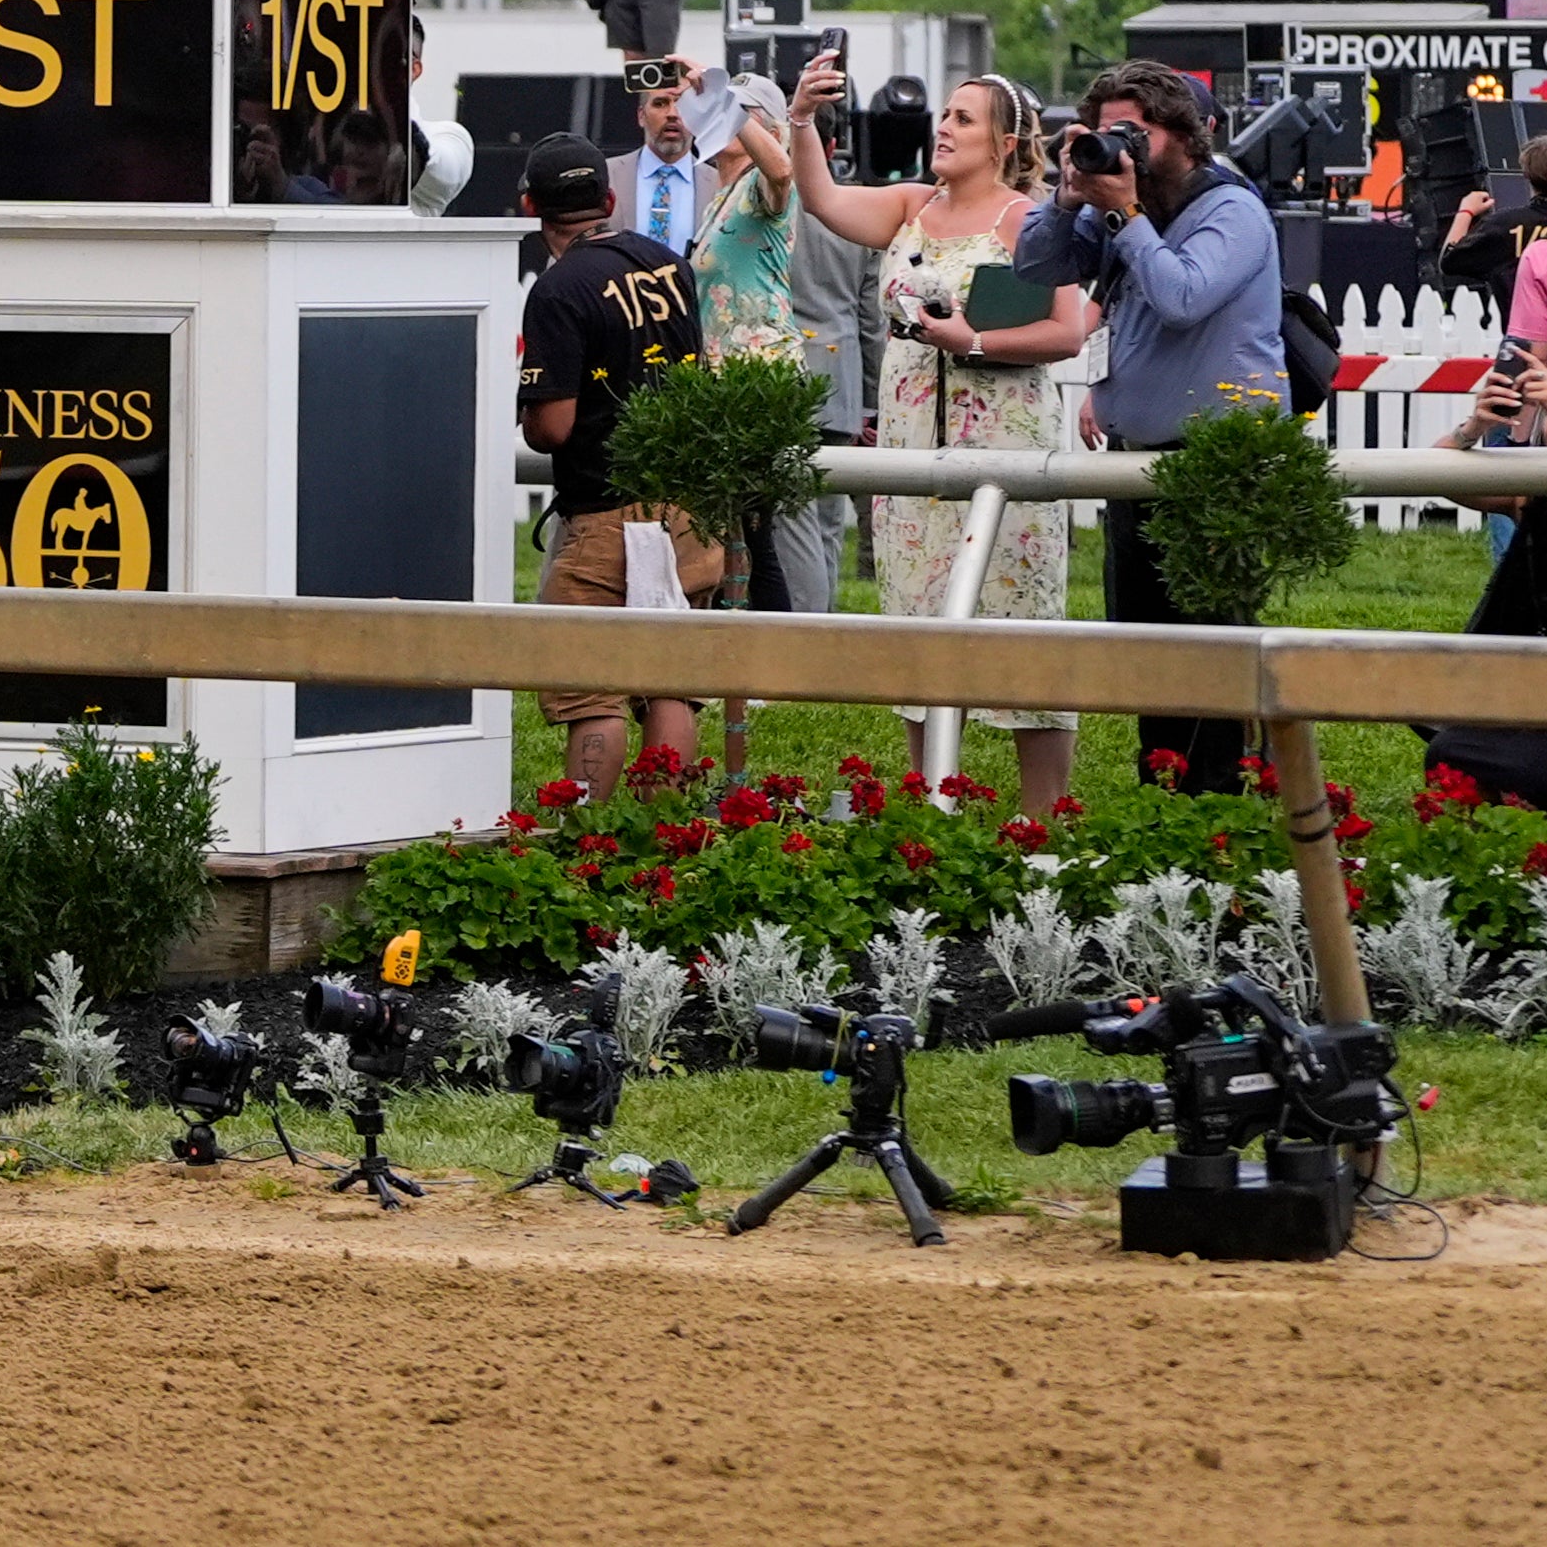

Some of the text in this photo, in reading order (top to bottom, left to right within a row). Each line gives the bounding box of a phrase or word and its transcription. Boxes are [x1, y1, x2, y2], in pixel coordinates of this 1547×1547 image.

[1299, 34, 1533, 69] PPROXIMATE
[602, 263, 688, 330] 1/ST
[519, 367, 543, 385] ST
